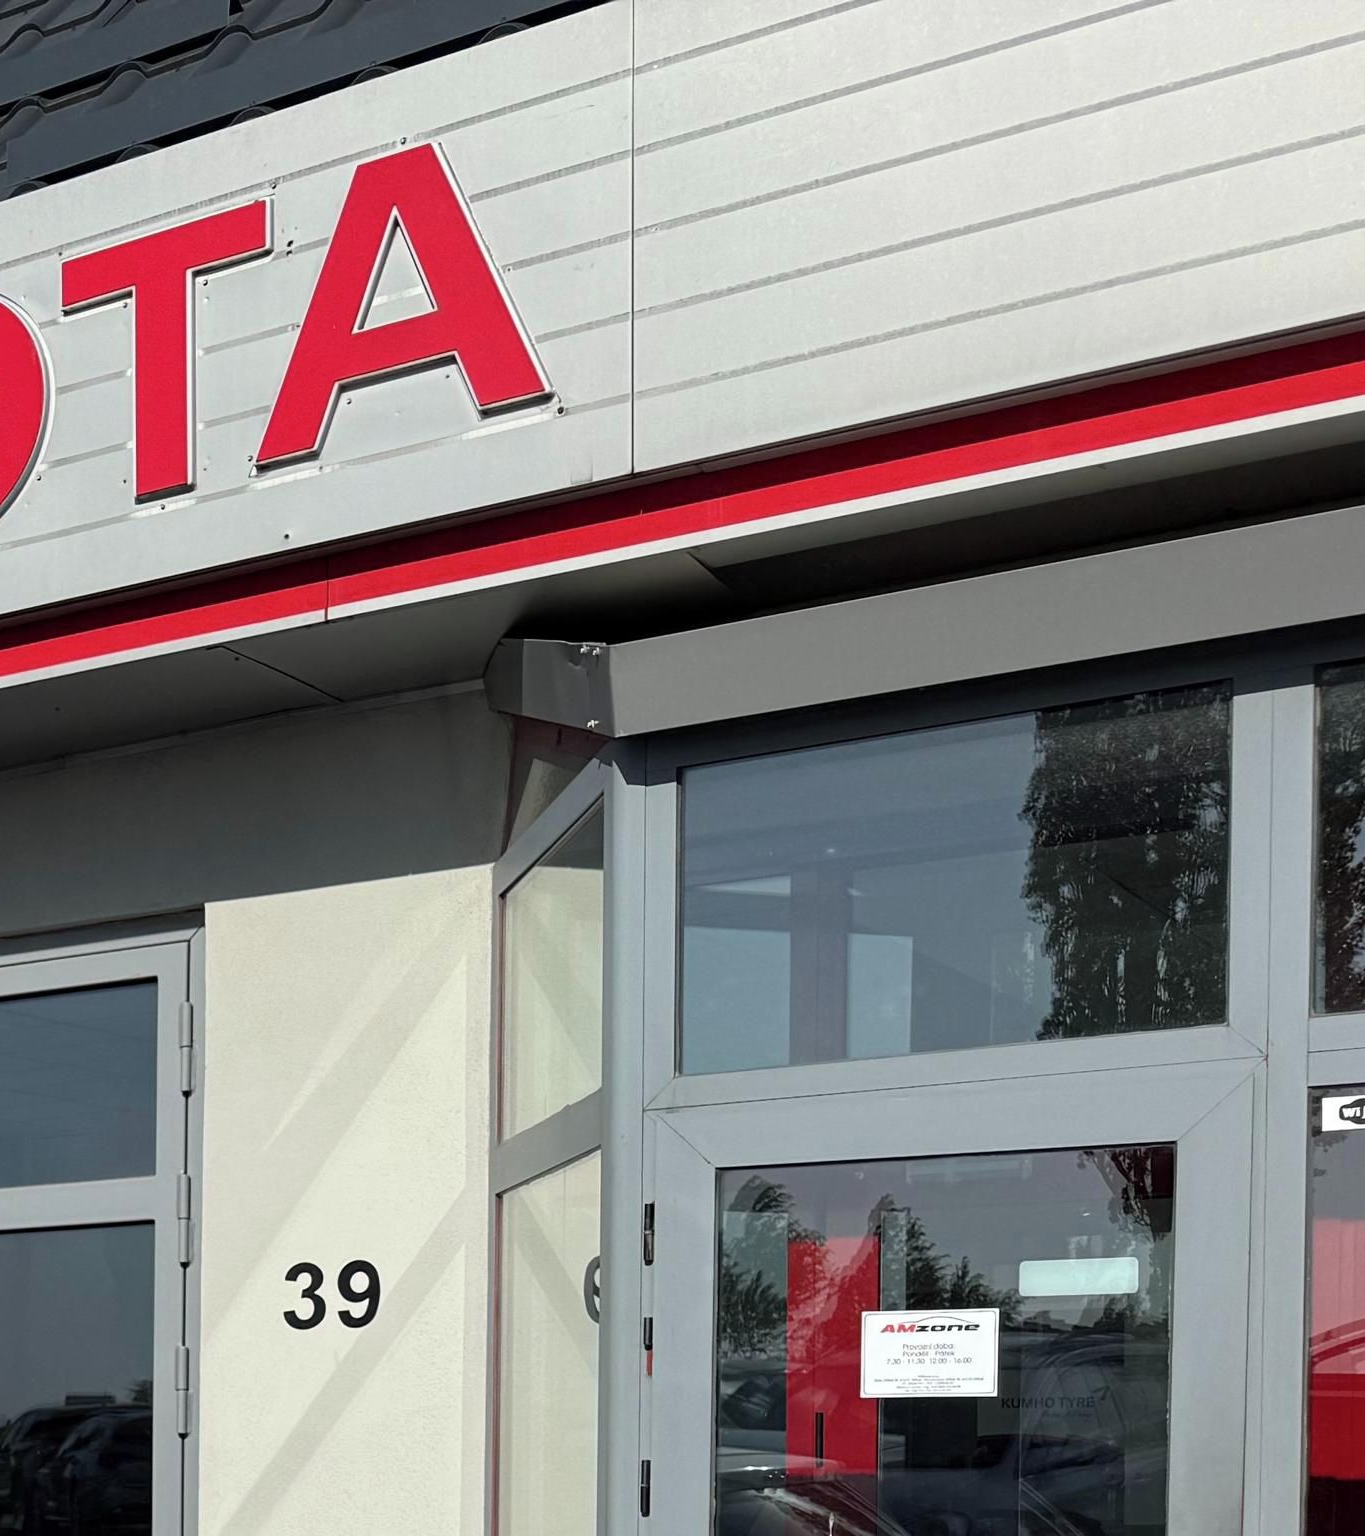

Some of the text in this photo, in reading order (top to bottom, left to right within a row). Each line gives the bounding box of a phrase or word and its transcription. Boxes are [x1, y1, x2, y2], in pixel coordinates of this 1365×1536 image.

[283, 1259, 381, 1330] 39
[880, 1323, 980, 1334] AMzone
[1001, 1396, 1095, 1409] KUMHO TYRE
